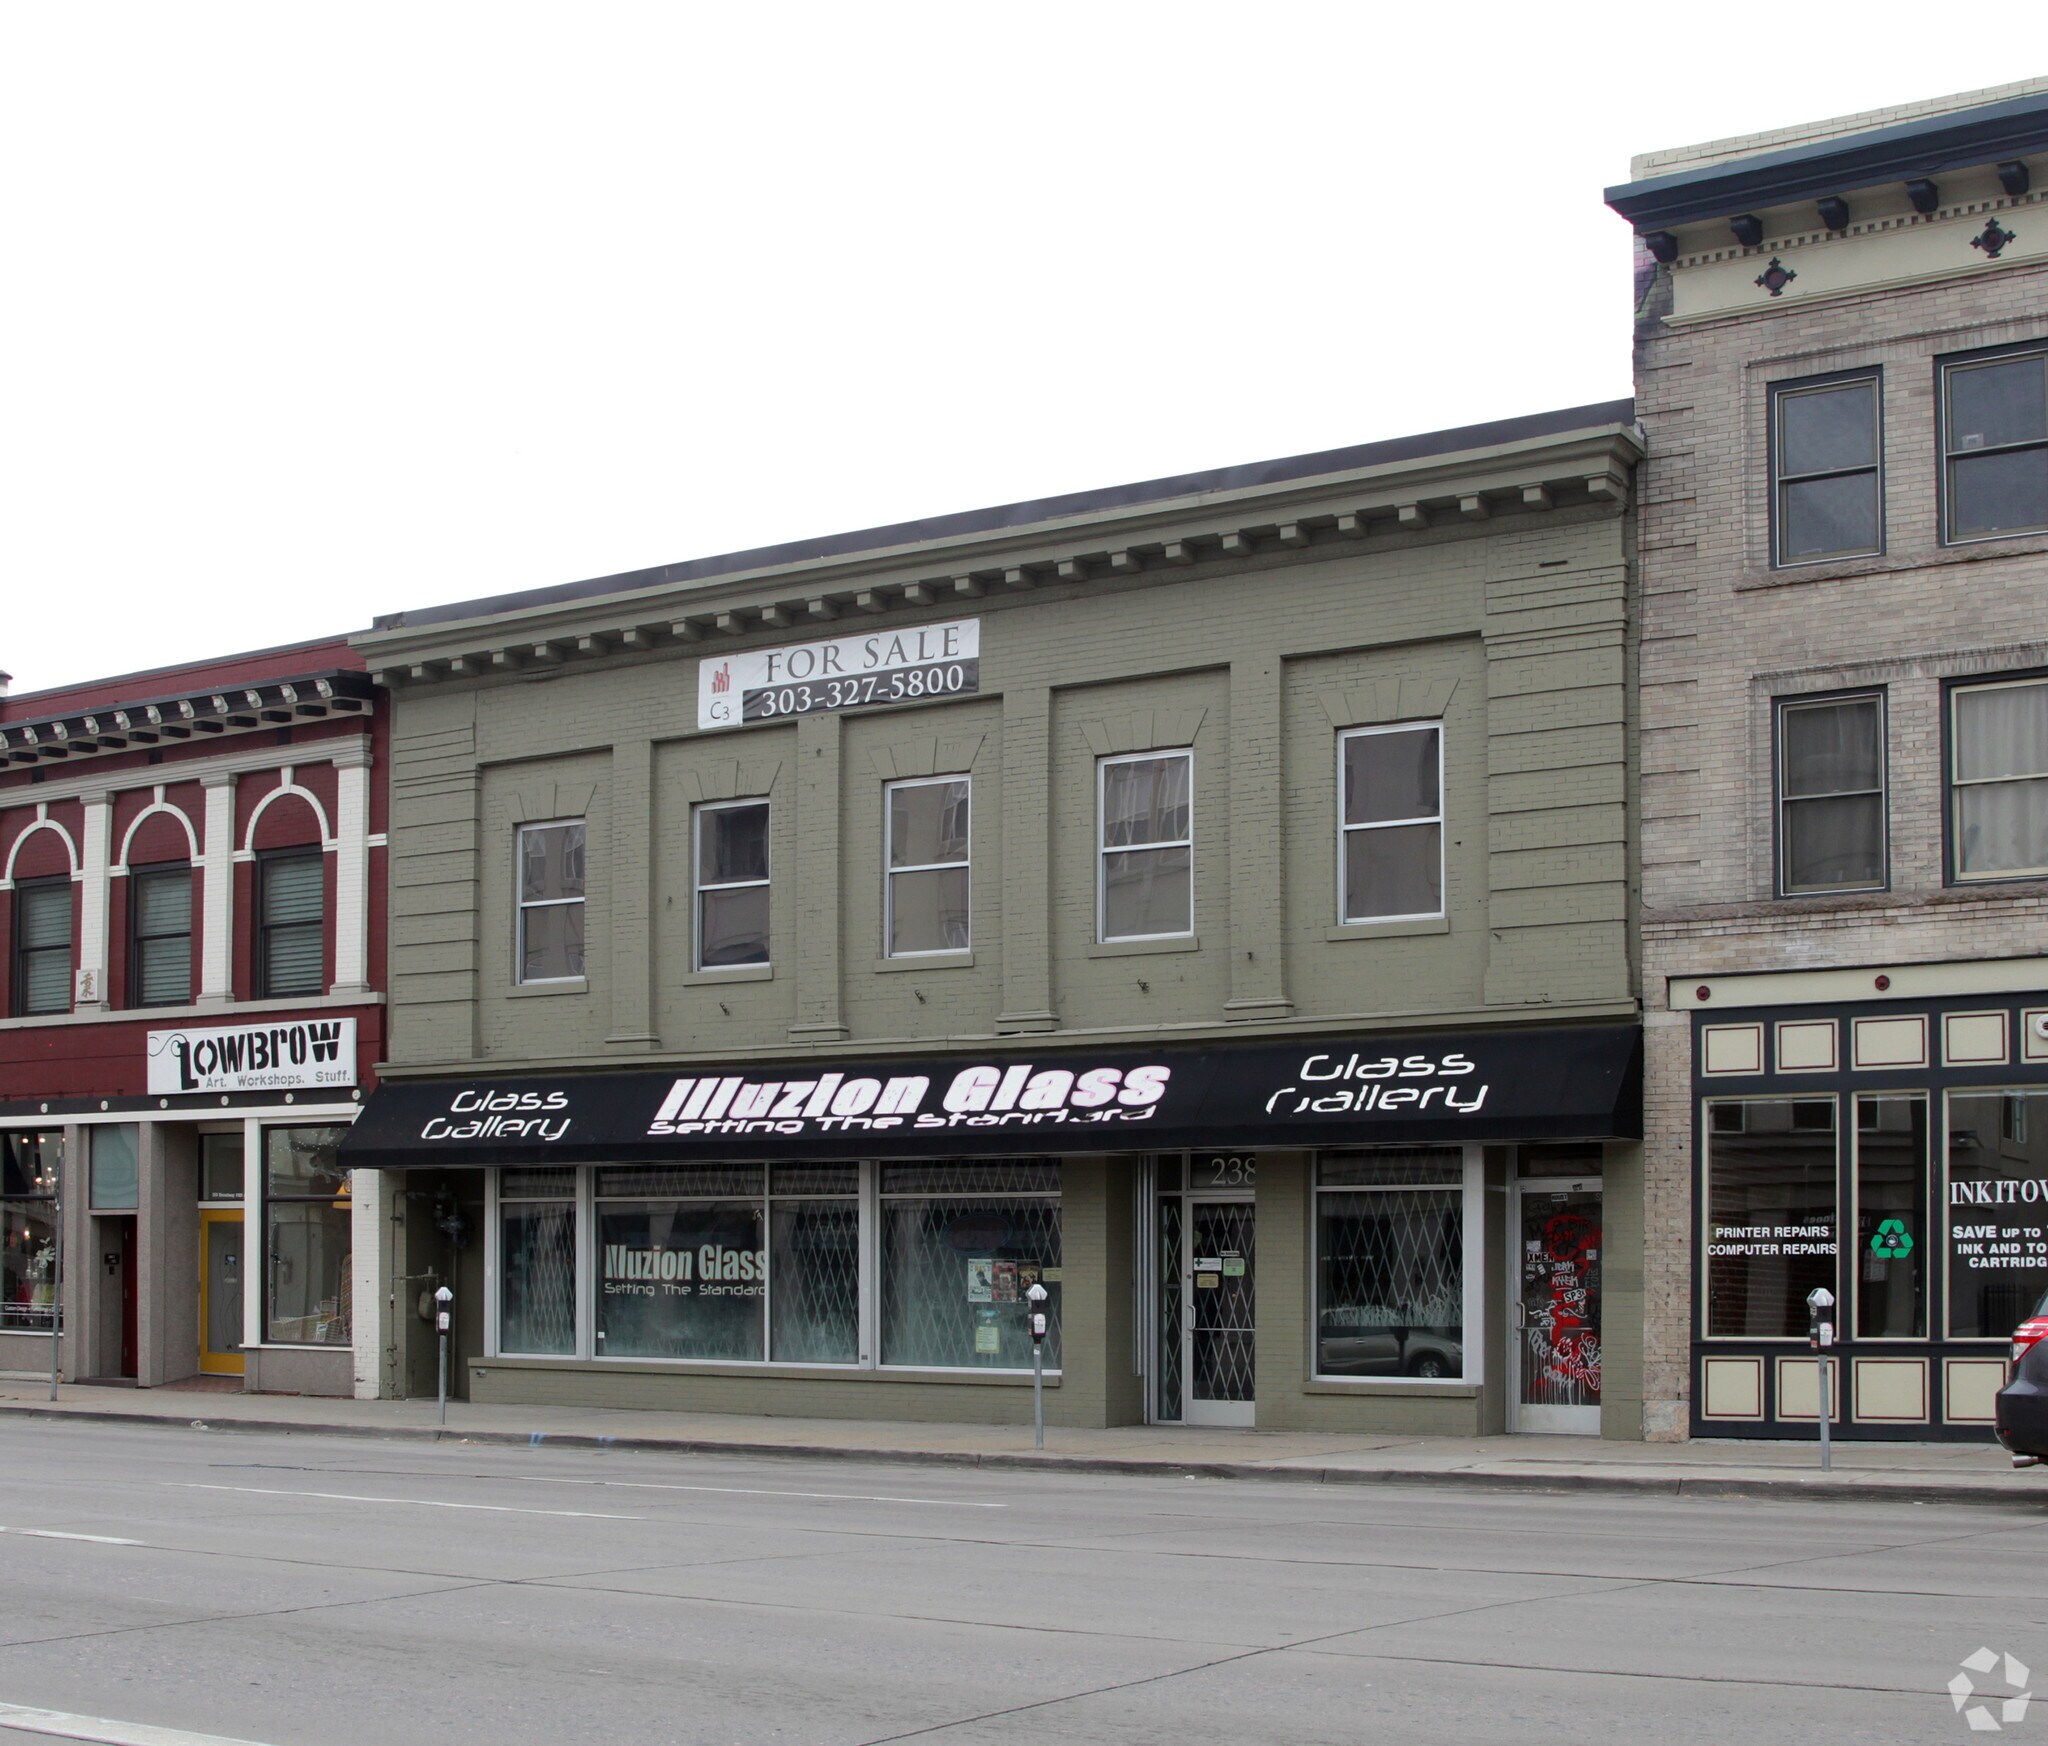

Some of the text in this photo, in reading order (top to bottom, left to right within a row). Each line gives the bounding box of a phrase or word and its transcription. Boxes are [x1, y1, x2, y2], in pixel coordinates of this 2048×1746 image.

[766, 626, 959, 682] FOR SALE
[761, 665, 964, 717] 303-327-5800
[710, 701, 730, 720] C3
[1300, 1053, 1475, 1080] Glass
[206, 1070, 350, 1088] Art. Workshops. Stuff.
[942, 1064, 1171, 1113] Glass
[450, 1090, 568, 1112] Glass
[421, 1115, 571, 1141] Gallery
[647, 1119, 804, 1135] Setting
[815, 1116, 903, 1131] The
[1715, 1226, 1829, 1238] PRINTER REPAIRS
[1952, 1225, 2041, 1239] SAVE UP TO
[1707, 1243, 1837, 1255] COMPUTER REPAIRS
[1957, 1243, 1984, 1254] INK
[1989, 1243, 2021, 1254] AND
[605, 1244, 765, 1280] Illuzion Glass
[1968, 1257, 2048, 1268] CARTRIDG
[604, 1283, 655, 1297] Setting
[662, 1284, 691, 1295] The
